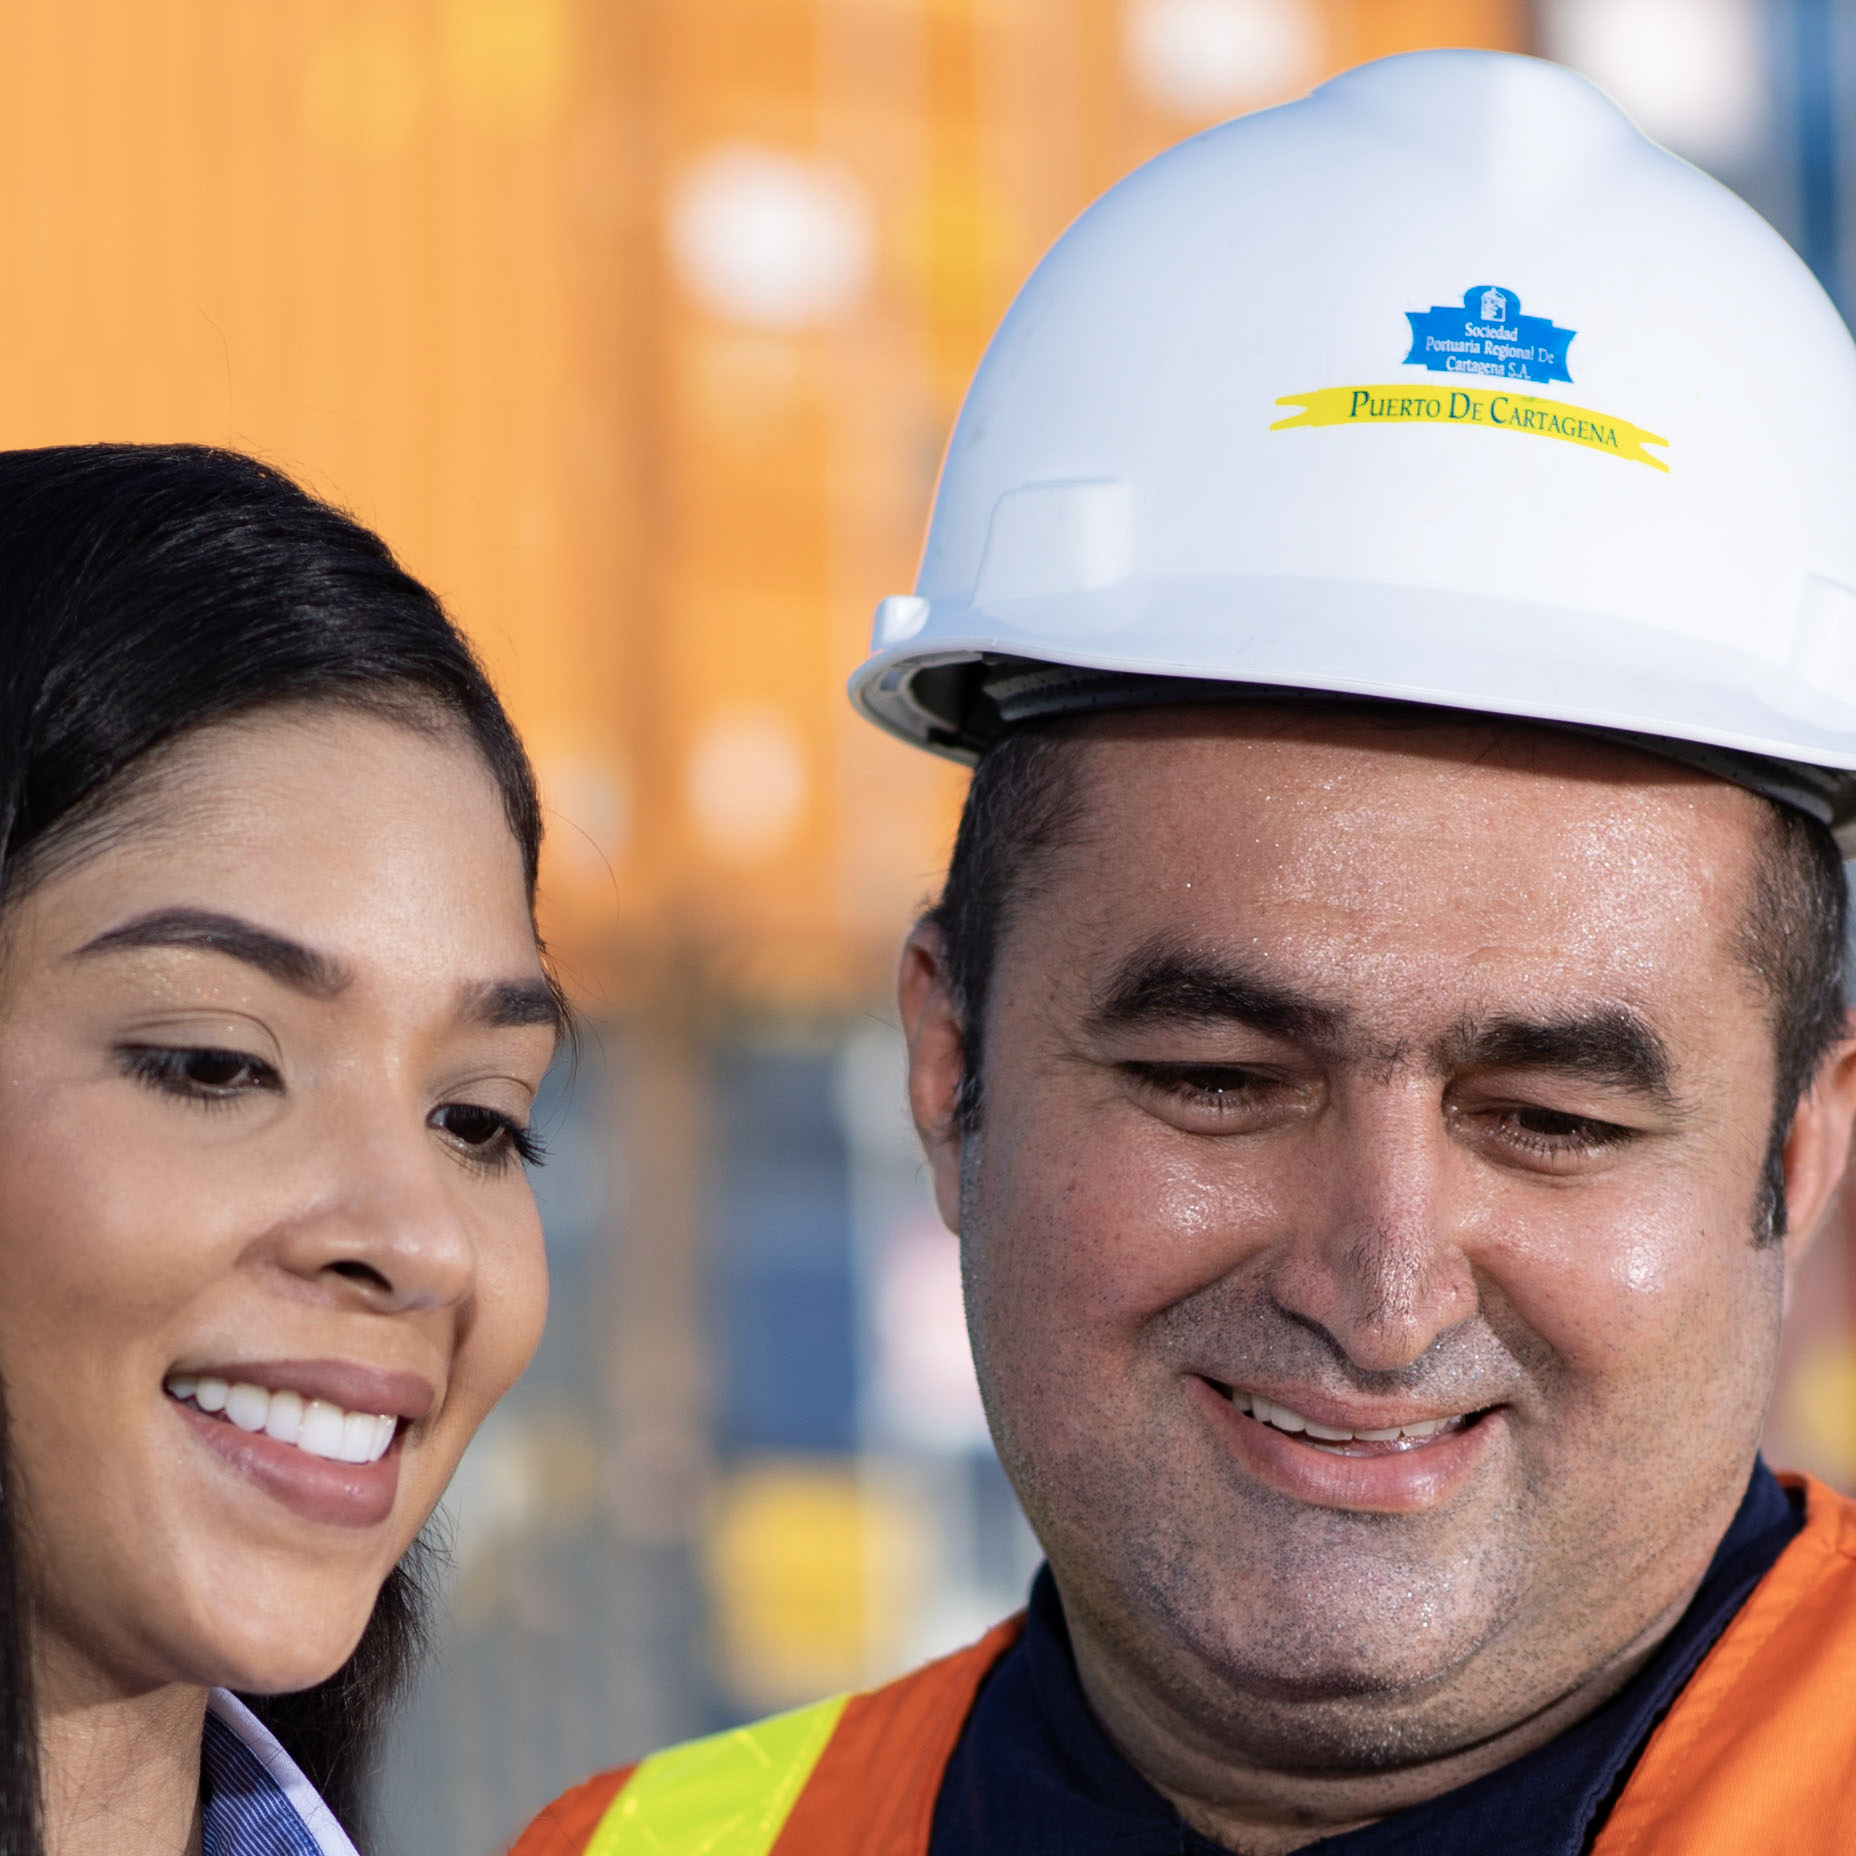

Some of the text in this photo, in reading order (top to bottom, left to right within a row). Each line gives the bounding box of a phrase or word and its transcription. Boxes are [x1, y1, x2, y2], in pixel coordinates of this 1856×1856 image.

[1464, 321, 1519, 342] Sociedad
[1425, 335, 1555, 365] Portuaria Regional De
[1445, 355, 1505, 376] Cartagena
[1348, 389, 1619, 448] PUERTO DE CARTAGENA
